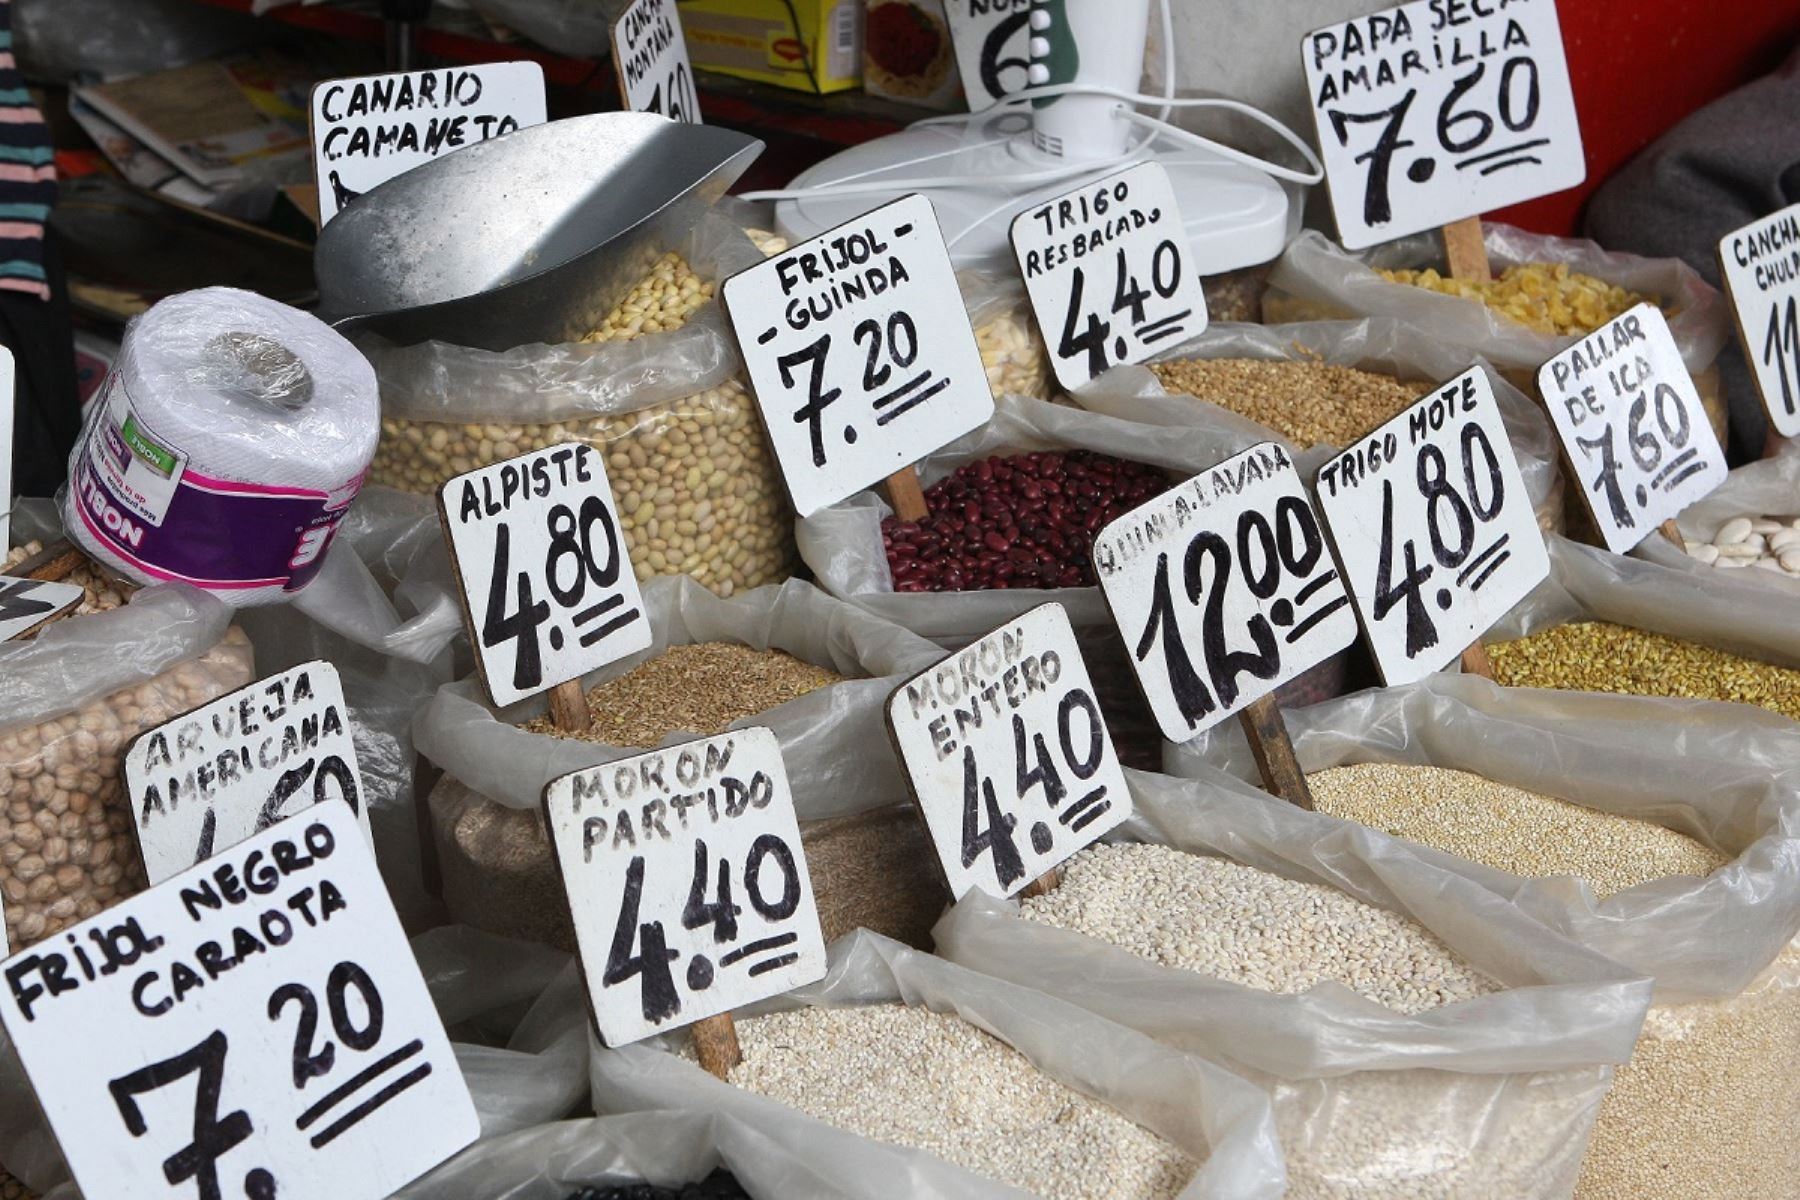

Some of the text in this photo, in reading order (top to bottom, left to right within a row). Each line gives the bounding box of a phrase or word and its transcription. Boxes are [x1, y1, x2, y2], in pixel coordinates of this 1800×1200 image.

[1313, 0, 1529, 70] PAPA SEC
[322, 71, 482, 122] CANARIO
[1328, 56, 1540, 228] 7.60
[1033, 181, 1129, 235] TRIGO
[1057, 239, 1181, 380] 4.40
[1552, 315, 1646, 392] PALLAR
[777, 310, 919, 468] 7.20
[1321, 376, 1477, 497] TRIGO MOTE
[1564, 355, 1653, 427] DE ICA
[460, 445, 591, 523] ALPISTE
[1576, 383, 1690, 529] 7.60
[483, 495, 620, 690] 4.80
[1374, 422, 1504, 659] 4.80
[907, 627, 1023, 719] MORON
[1136, 496, 1322, 730] 12.00
[142, 705, 342, 828] AMERICANA
[928, 650, 1061, 762] ENTERO
[572, 739, 735, 814] MORON
[583, 771, 773, 863] PARTIDO
[961, 688, 1103, 892] 4.40
[180, 823, 335, 921] NEGRO
[603, 833, 801, 1025] 4.40
[132, 880, 346, 1017] CARAOTA
[109, 961, 383, 1200] 7.20
